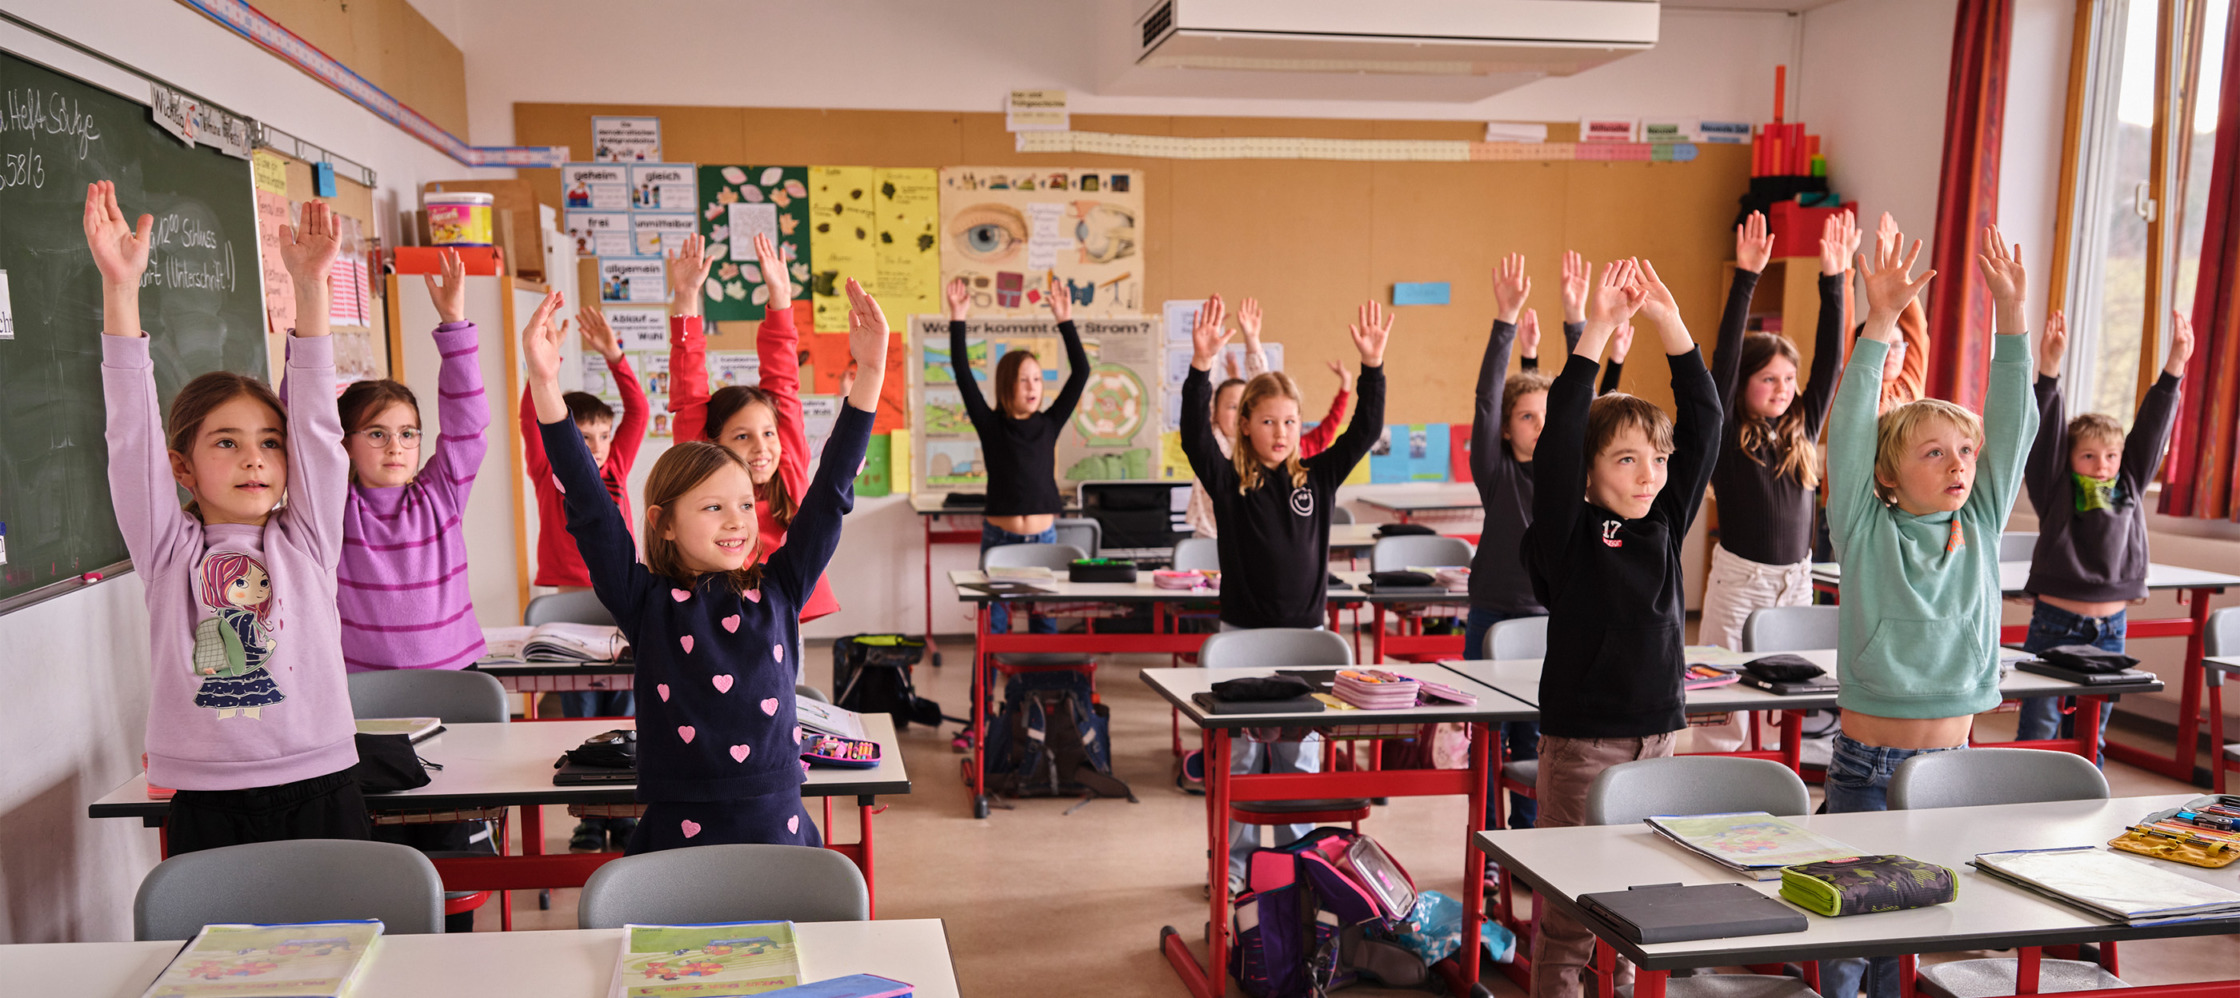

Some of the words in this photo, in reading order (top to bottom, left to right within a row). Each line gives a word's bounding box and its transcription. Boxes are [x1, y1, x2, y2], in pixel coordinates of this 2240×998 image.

[574, 170, 617, 180] geheim
[645, 171, 681, 181] gleich
[588, 218, 609, 227] frei
[634, 218, 693, 228] unmittelbar
[605, 264, 660, 275] allgemein
[612, 314, 647, 323] Ablauf
[922, 322, 981, 334] Woer
[984, 321, 1048, 334] kommt
[1085, 322, 1138, 335] Strom
[1602, 519, 1622, 539] 17
